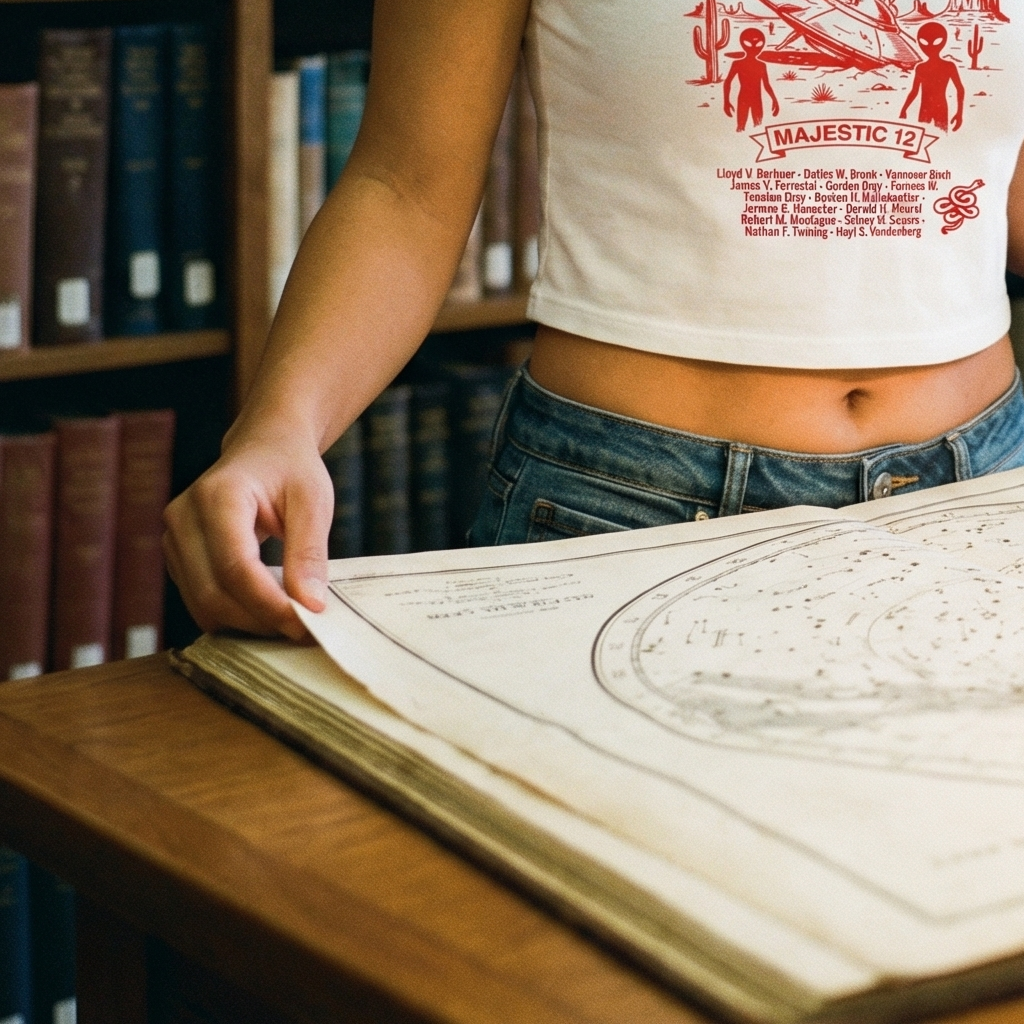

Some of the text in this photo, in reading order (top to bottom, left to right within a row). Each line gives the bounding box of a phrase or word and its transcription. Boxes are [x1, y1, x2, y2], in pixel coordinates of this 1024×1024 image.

[773, 124, 917, 148] MAJESTIC 12
[850, 169, 878, 180] Bronk
[745, 226, 780, 237] Nathan
[792, 226, 828, 239] Twining
